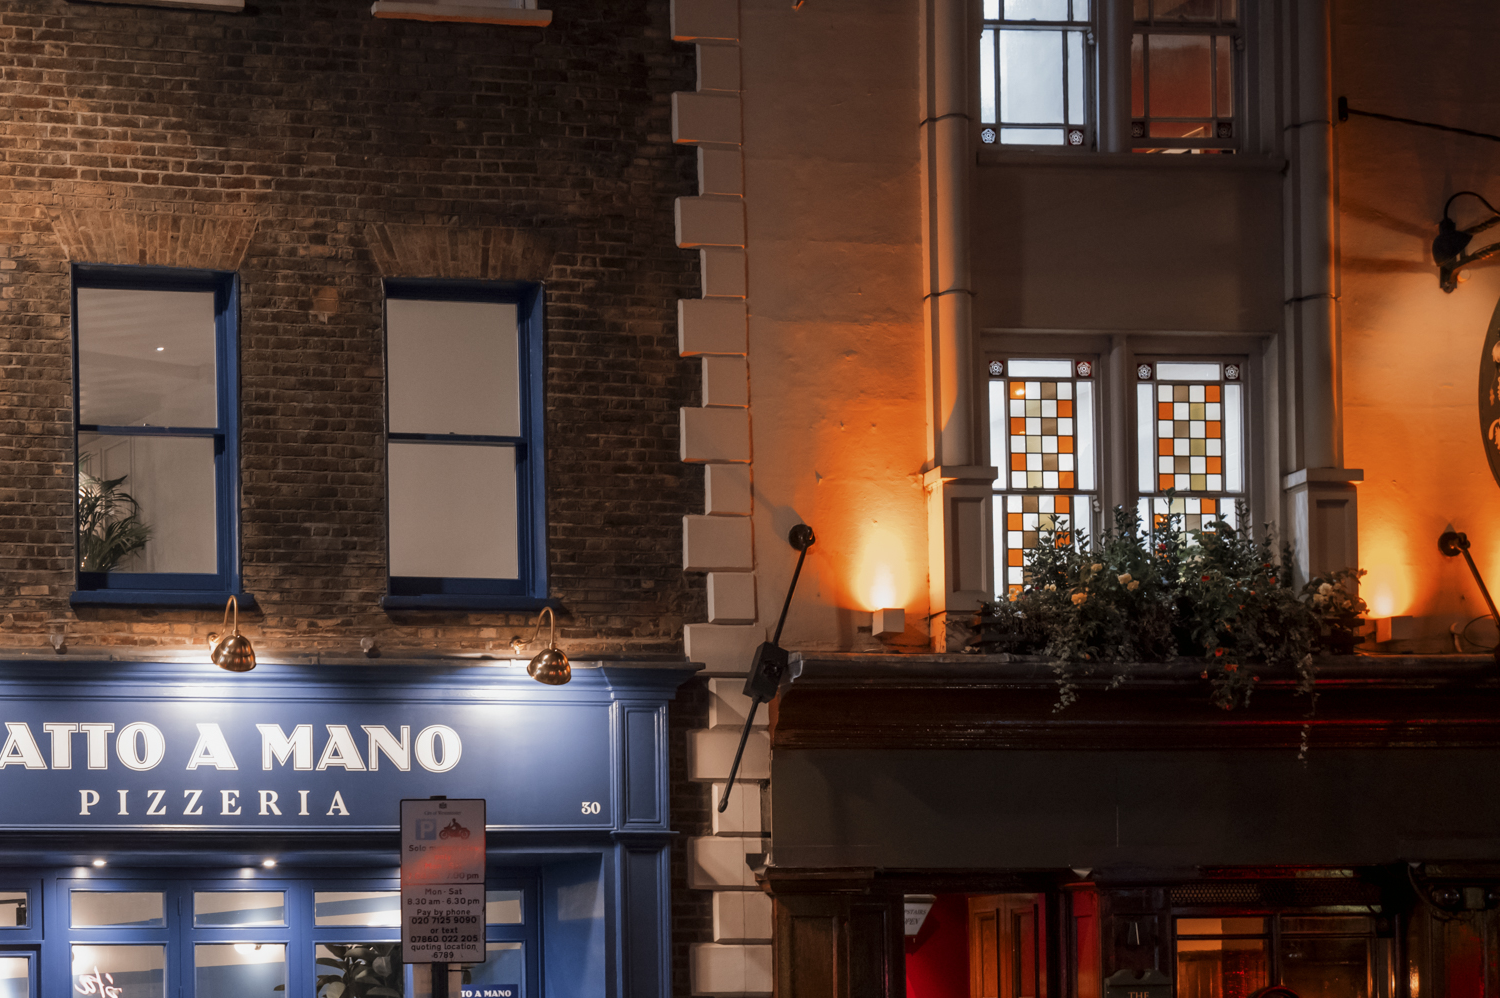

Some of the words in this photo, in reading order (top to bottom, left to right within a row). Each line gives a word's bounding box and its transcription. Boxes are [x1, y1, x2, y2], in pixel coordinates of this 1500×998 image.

[186, 722, 239, 771] A
[255, 723, 463, 773] MANO
[78, 789, 350, 816] PIZZERIA
[581, 801, 601, 815] 30
[408, 844, 426, 852] Solo
[424, 888, 443, 896] Mon
[448, 887, 462, 895] Sat
[407, 897, 427, 905] 8.30
[446, 897, 466, 905] 6.30
[417, 909, 431, 917] Pay
[434, 909, 444, 917] by
[446, 909, 471, 917] phone
[411, 916, 429, 925] 020
[431, 916, 451, 924] 7125
[453, 916, 477, 924] 9090
[441, 935, 459, 943] 022
[411, 944, 441, 952] quoting
[433, 951, 454, 959] 6789
[474, 990, 482, 998] A
[483, 990, 512, 998] MANO
